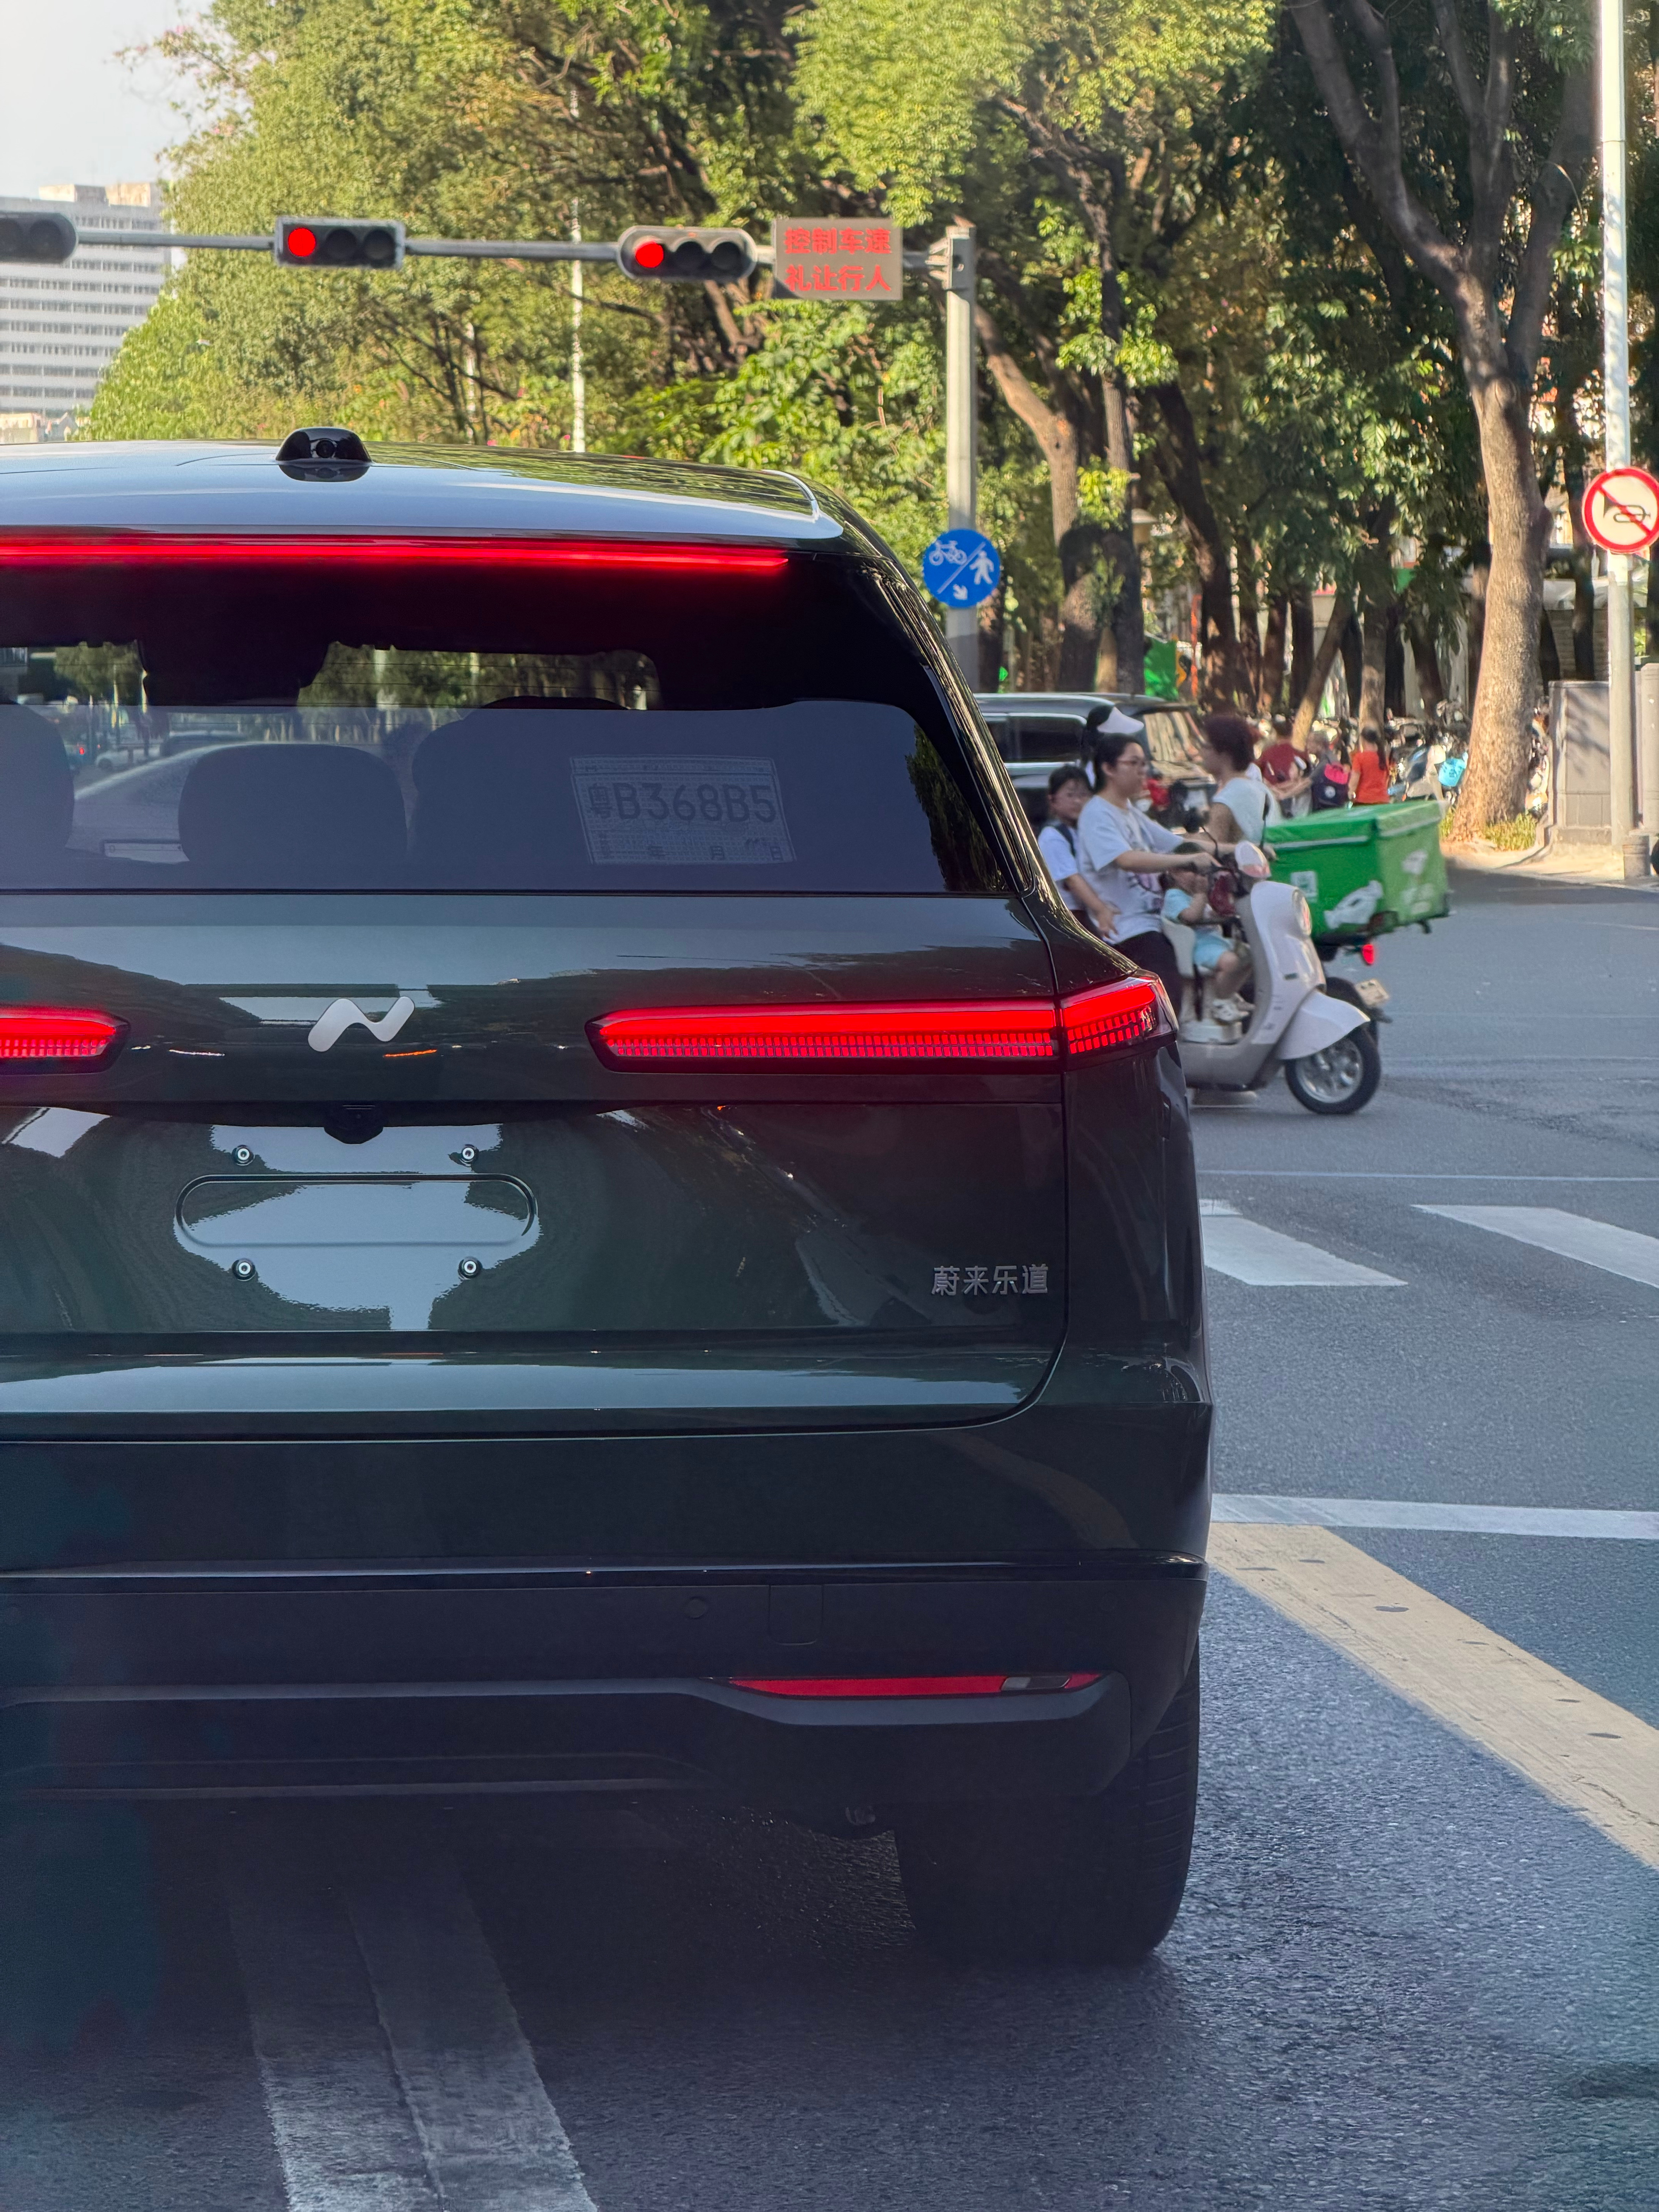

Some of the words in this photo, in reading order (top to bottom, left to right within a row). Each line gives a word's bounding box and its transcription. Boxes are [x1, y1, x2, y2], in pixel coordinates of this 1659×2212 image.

[784, 227, 891, 254] 控制车速
[784, 264, 891, 292] 礼让行人
[588, 782, 776, 823] 粤B368B5
[931, 1263, 1048, 1295] 蔚来乐道
